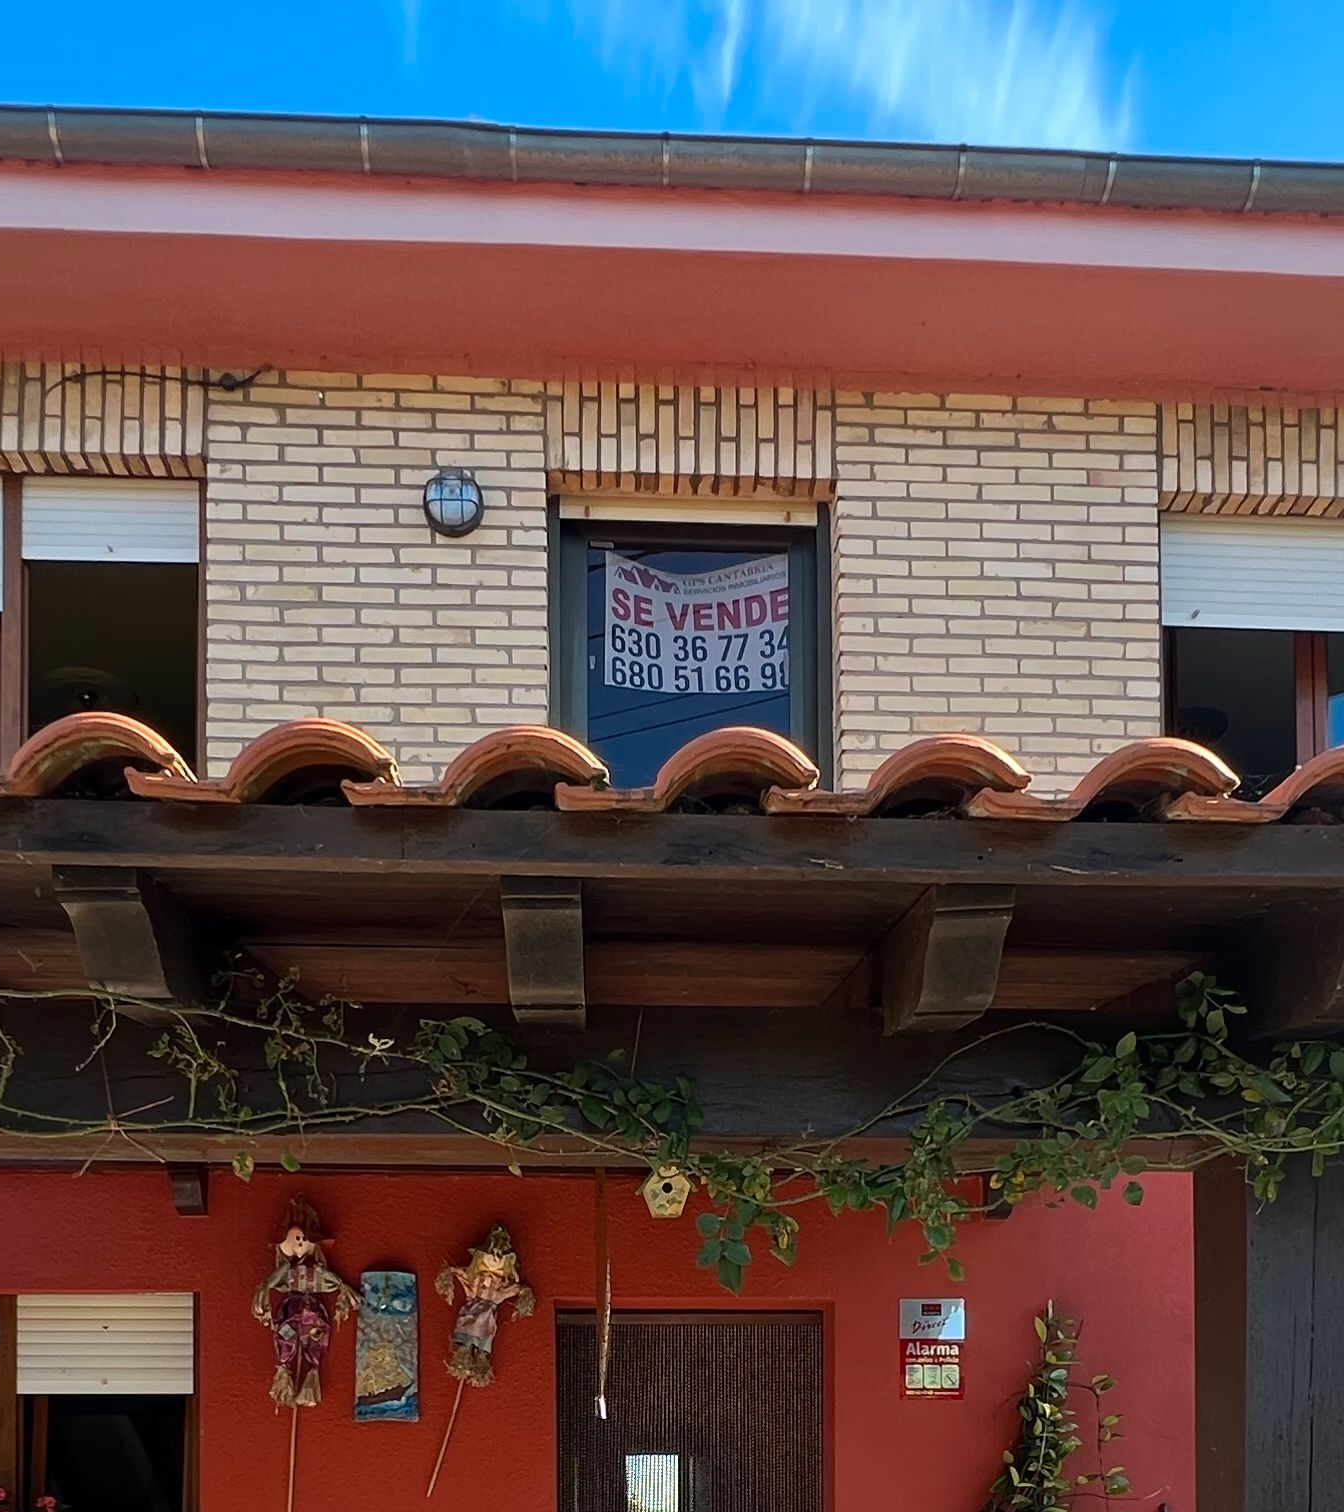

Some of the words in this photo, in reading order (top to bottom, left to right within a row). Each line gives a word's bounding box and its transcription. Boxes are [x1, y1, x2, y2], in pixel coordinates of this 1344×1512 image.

[708, 563, 773, 584] CANTABRIA
[611, 587, 654, 628] SE
[665, 587, 789, 631] VENDE
[611, 623, 661, 660] 630
[673, 635, 708, 662] 36
[717, 633, 749, 662] 77
[759, 625, 789, 659] 34
[611, 657, 663, 690] 680
[674, 666, 704, 692] 51
[715, 664, 750, 691] 66
[906, 1341, 959, 1356] Alarma
